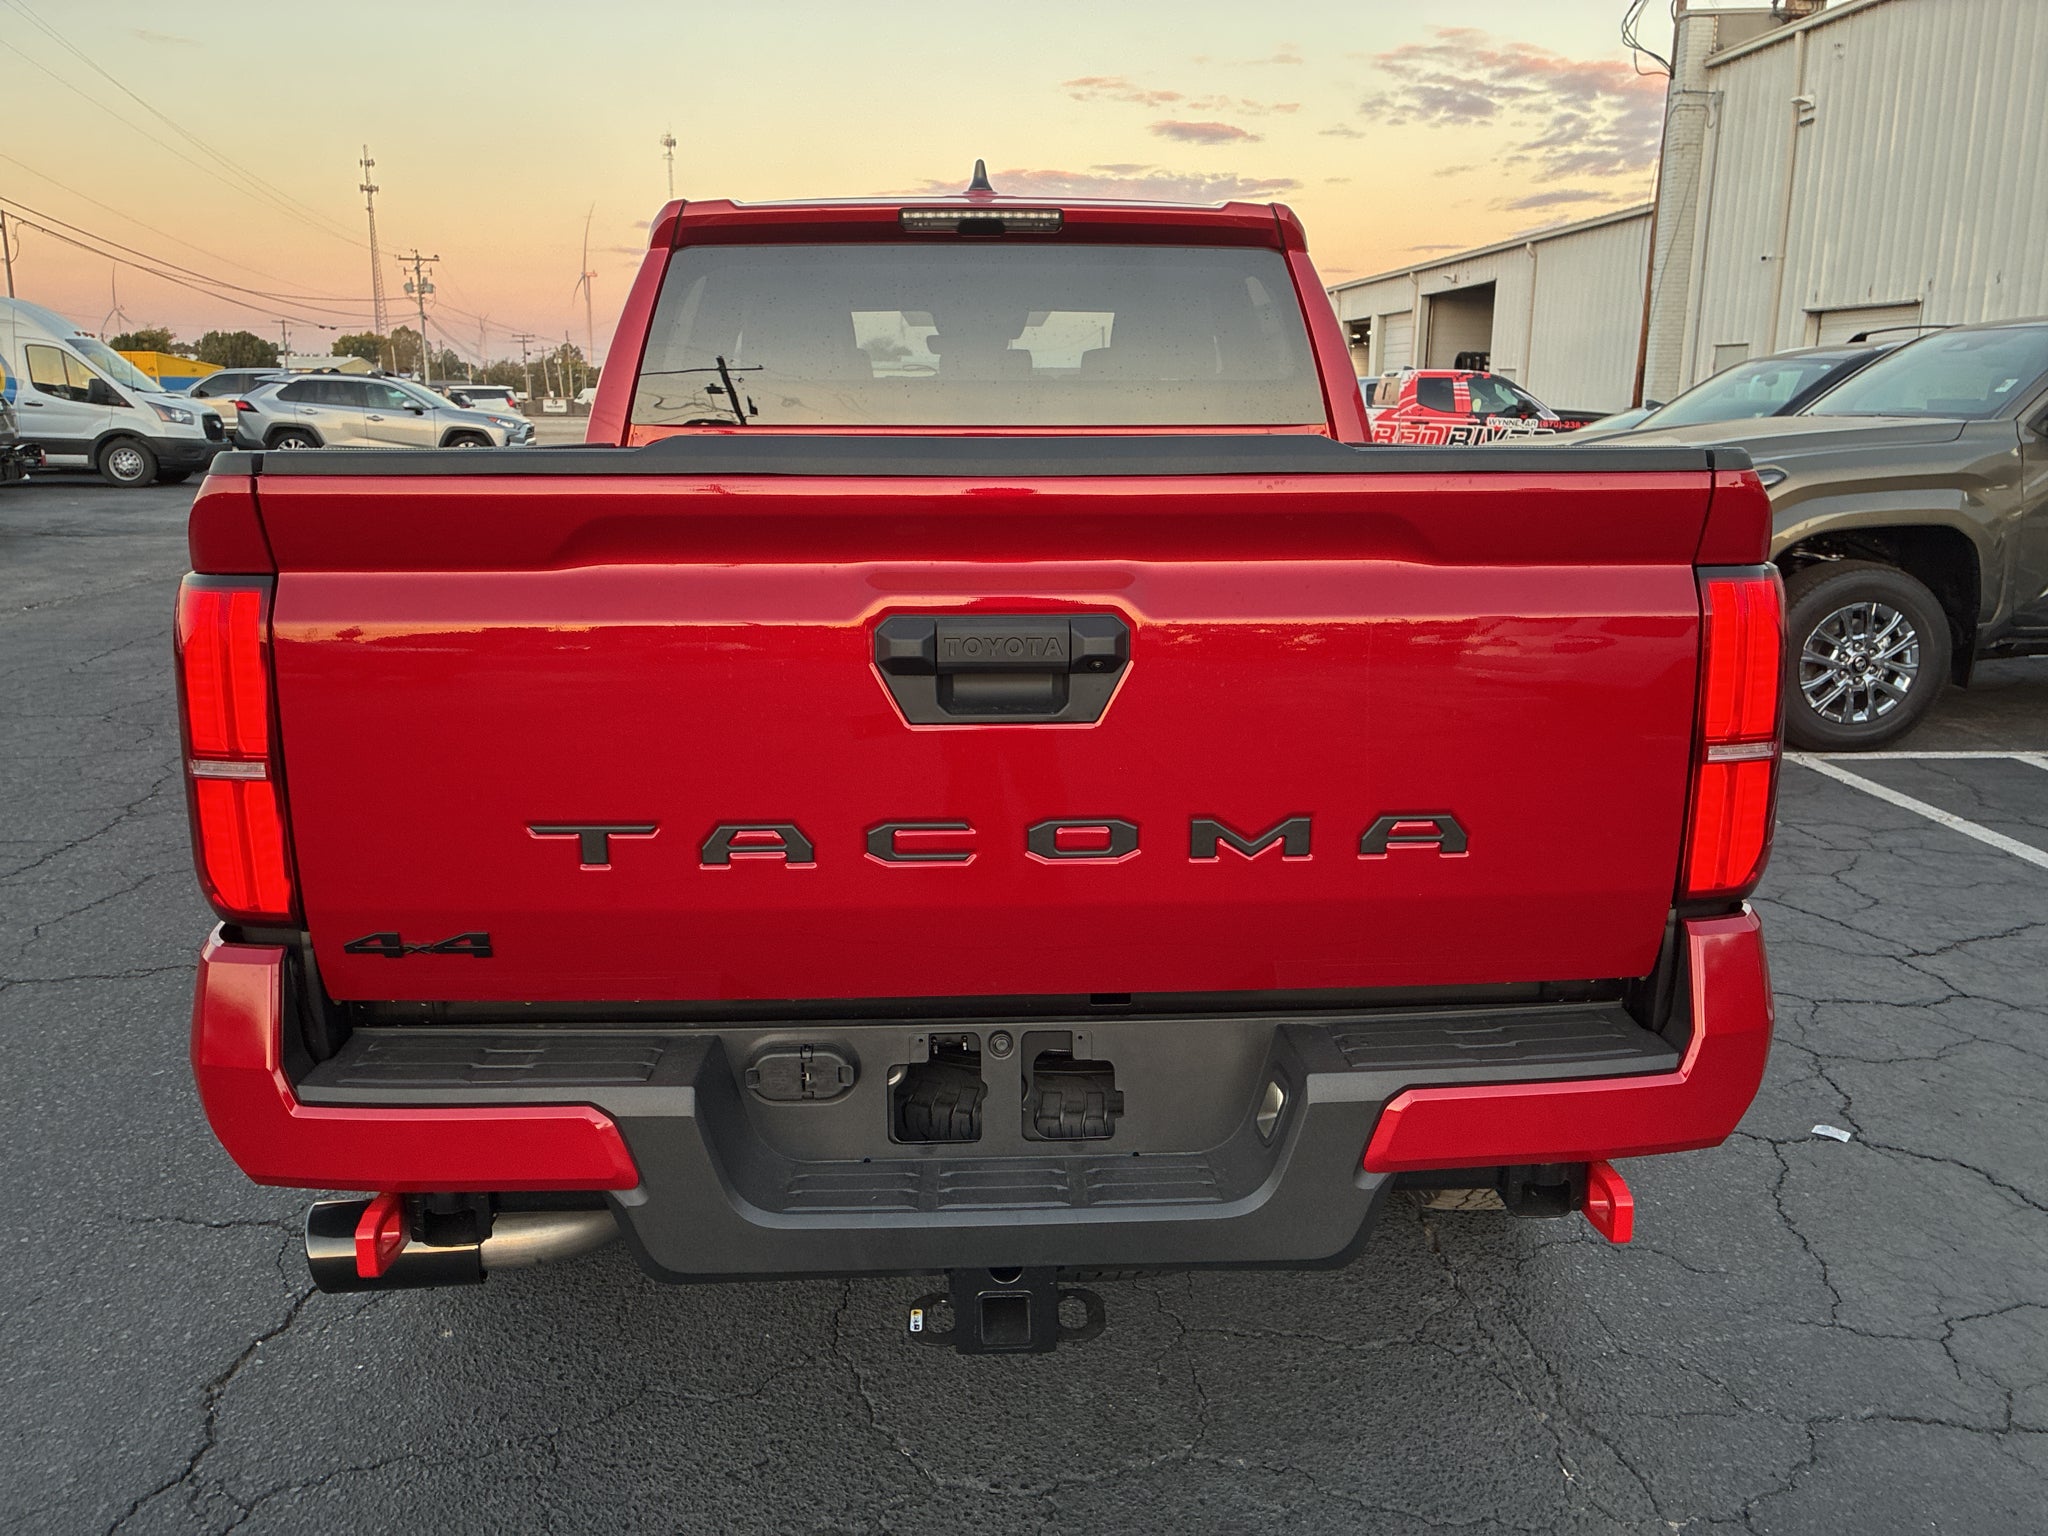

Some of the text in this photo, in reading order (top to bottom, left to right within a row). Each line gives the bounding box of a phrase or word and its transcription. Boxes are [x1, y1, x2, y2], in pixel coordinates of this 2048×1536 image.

[1524, 419, 1538, 427] AR
[943, 636, 1064, 657] TOYOTA
[526, 813, 1468, 870] TACOMA
